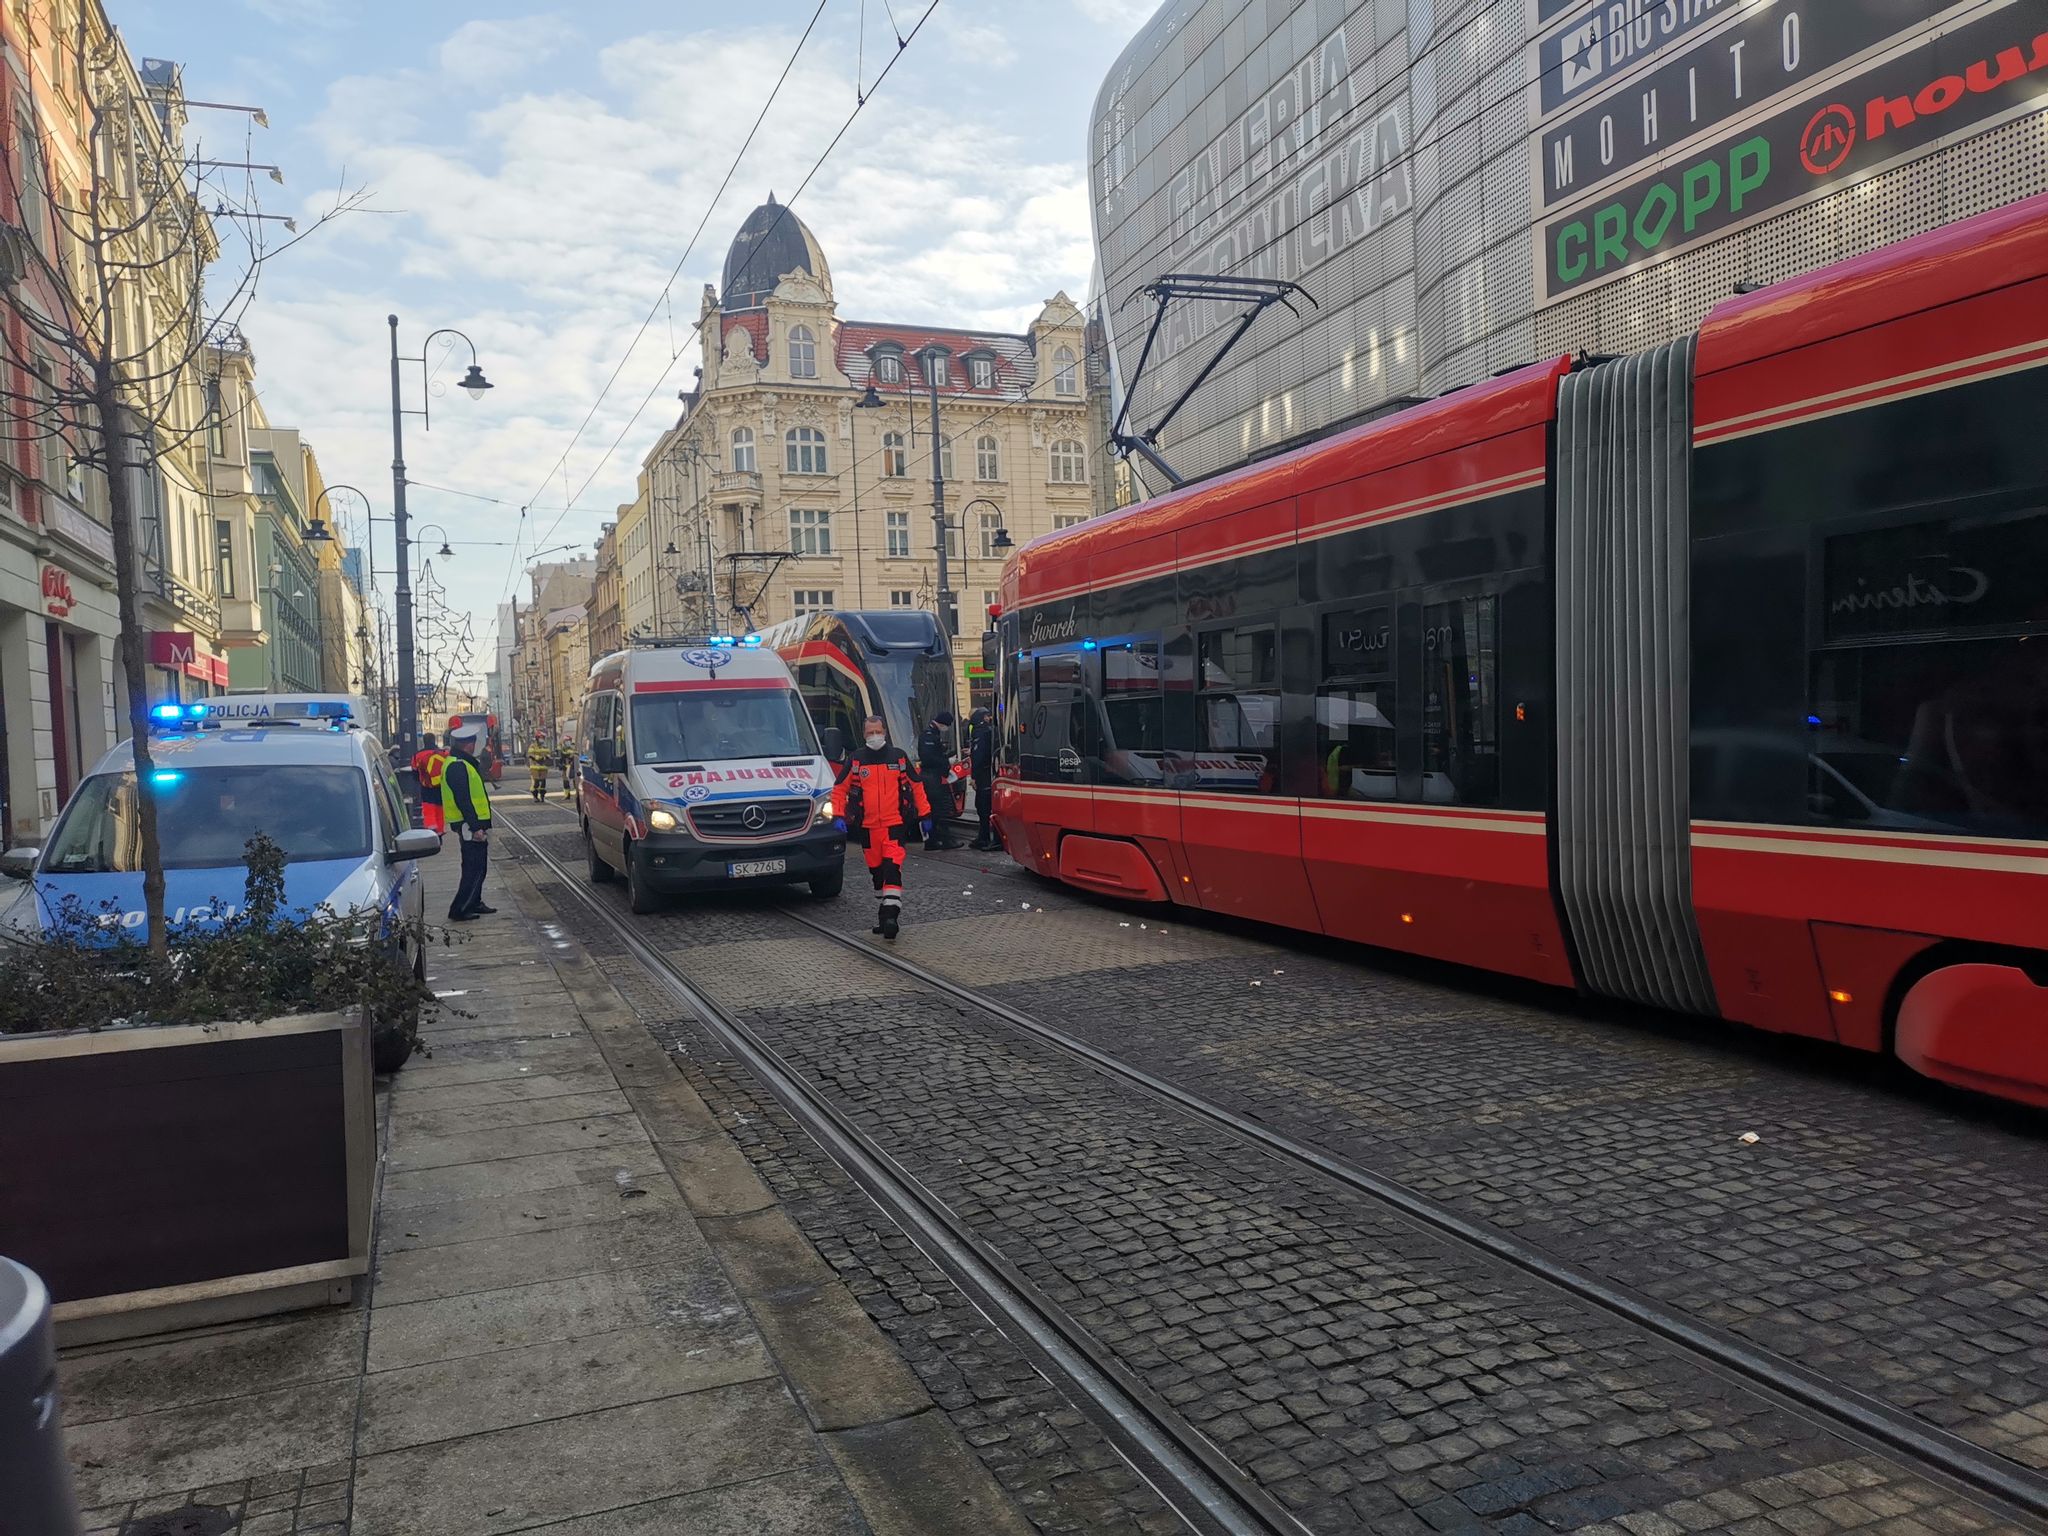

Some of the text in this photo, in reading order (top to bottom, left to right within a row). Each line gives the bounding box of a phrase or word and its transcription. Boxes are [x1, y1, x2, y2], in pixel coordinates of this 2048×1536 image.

[1609, 0, 1651, 67] BIG
[1554, 12, 1800, 190] MOHITO
[1168, 25, 1357, 261] GALERIA
[1556, 135, 1770, 282] CROPP
[1029, 605, 1077, 644] Gwarek
[208, 704, 270, 718] POLICJA
[1059, 757, 1079, 767] pesa
[735, 860, 785, 875] SK 276LS
